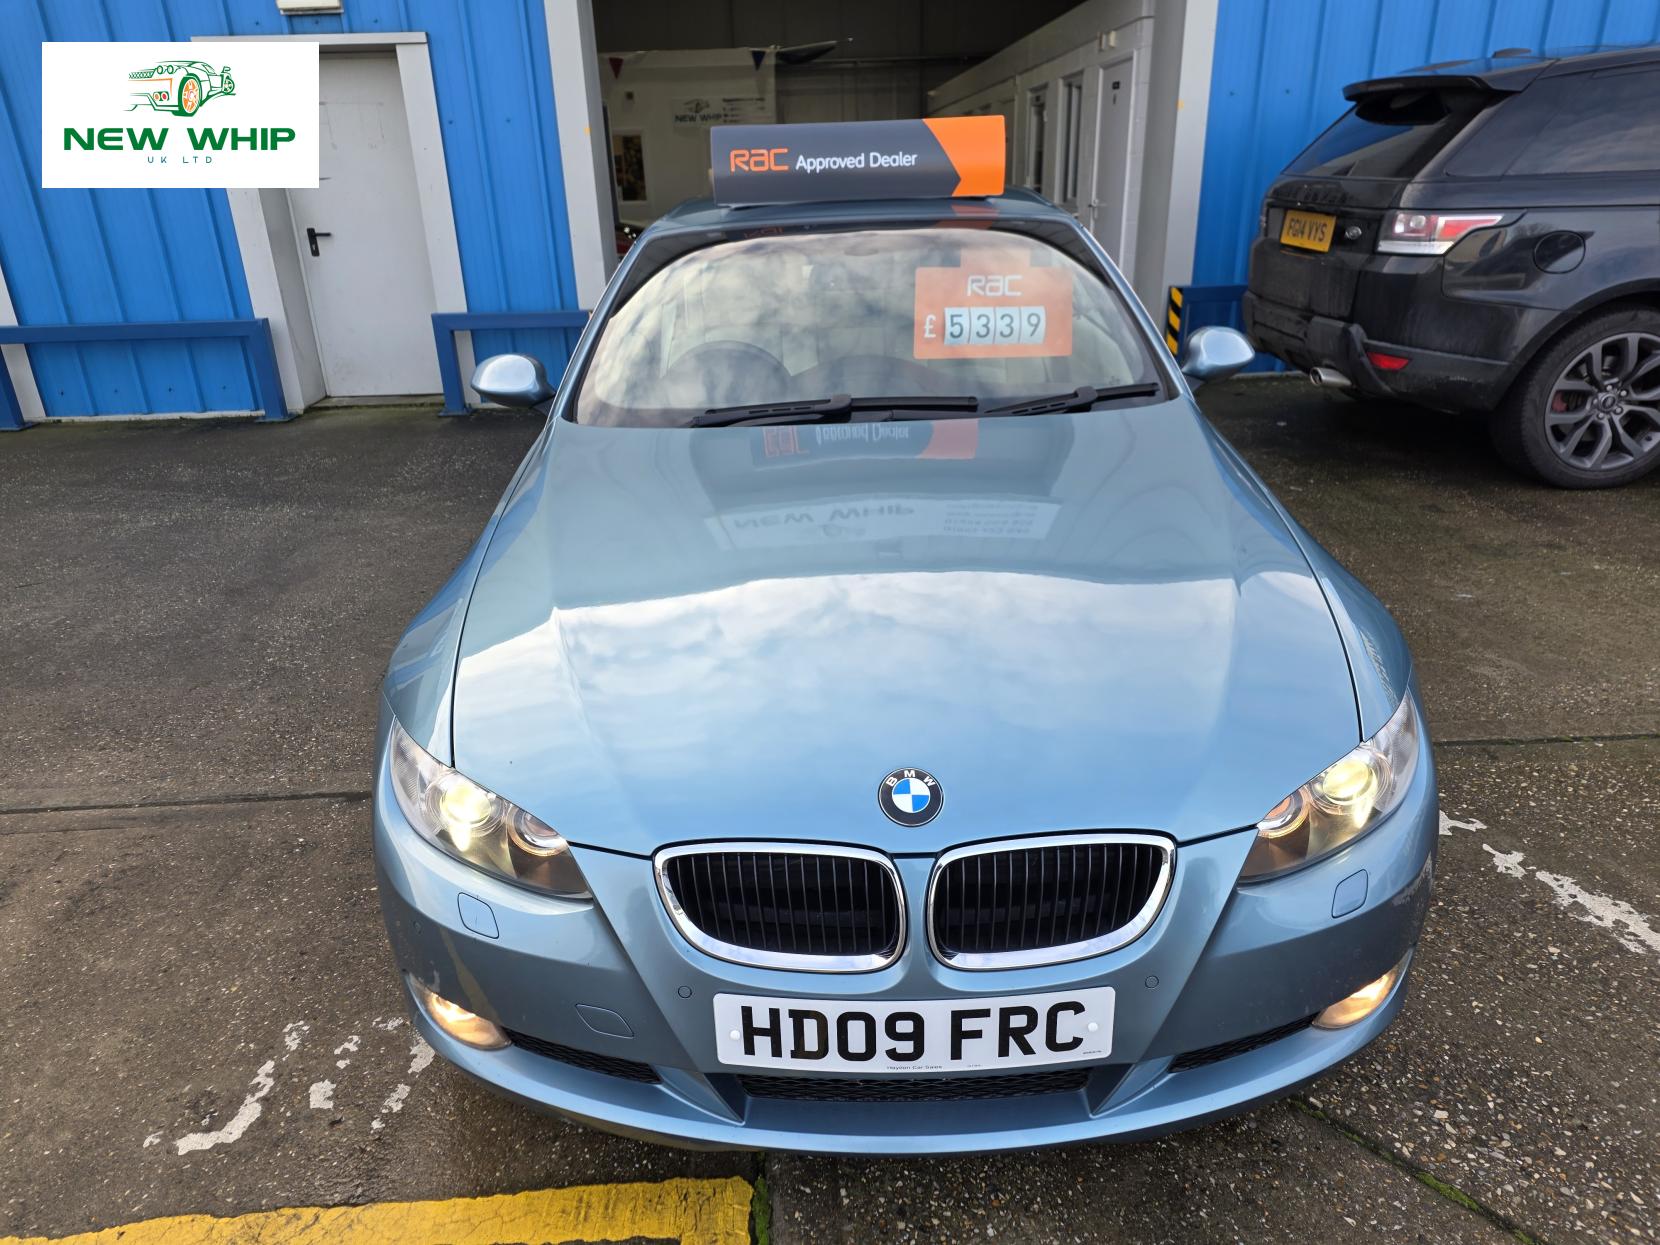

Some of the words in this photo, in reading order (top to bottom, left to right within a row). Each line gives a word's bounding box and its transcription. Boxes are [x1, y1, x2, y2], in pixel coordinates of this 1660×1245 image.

[795, 153, 865, 174] Approved
[869, 151, 918, 168] Dealer
[886, 769, 936, 787] BMW
[740, 1005, 925, 1062] HD09
[950, 1000, 1086, 1061] FRC
